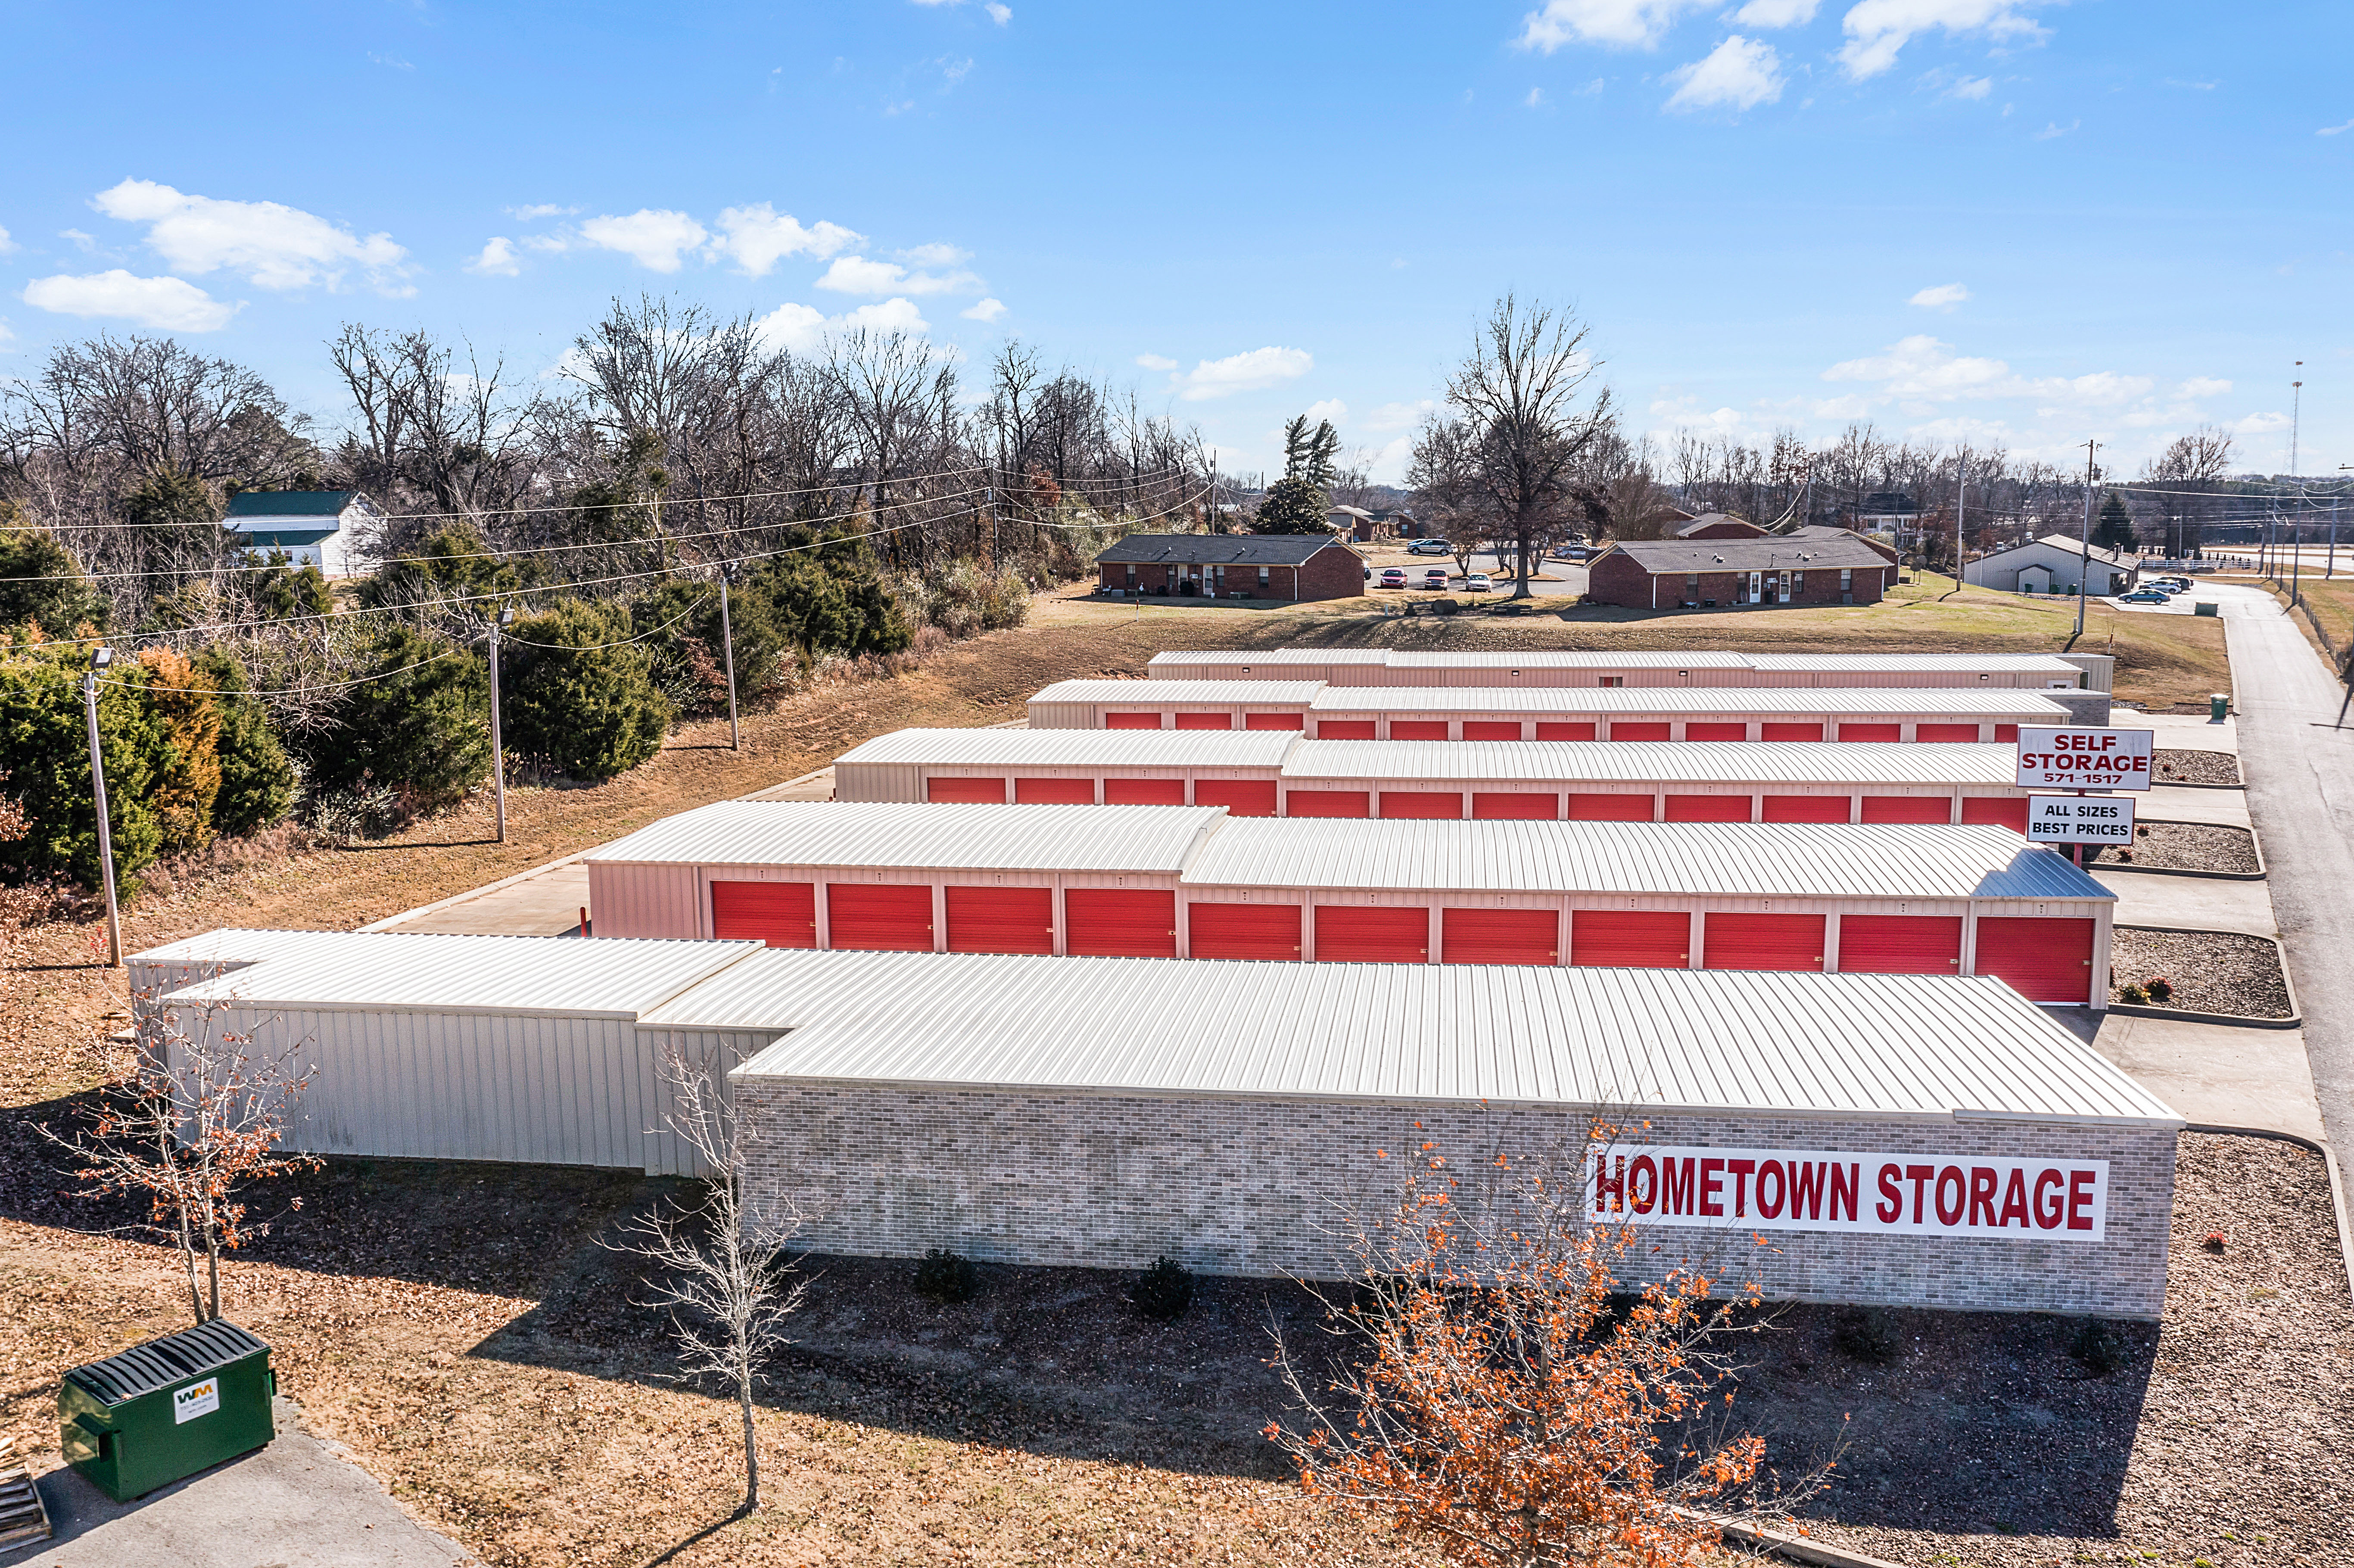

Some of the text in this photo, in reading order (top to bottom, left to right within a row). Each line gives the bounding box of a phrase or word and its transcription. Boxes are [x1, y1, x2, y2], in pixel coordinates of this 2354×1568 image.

[2055, 734, 2116, 751] SELF
[2022, 753, 2147, 772] STORAGE
[2044, 773, 2122, 784] 571-1517
[2045, 805, 2118, 818] ALL SIZES
[2033, 822, 2128, 836] BEST PRICES
[1596, 1154, 2096, 1230] HOMETOWN STORAGE
[177, 1384, 213, 1404] WM
